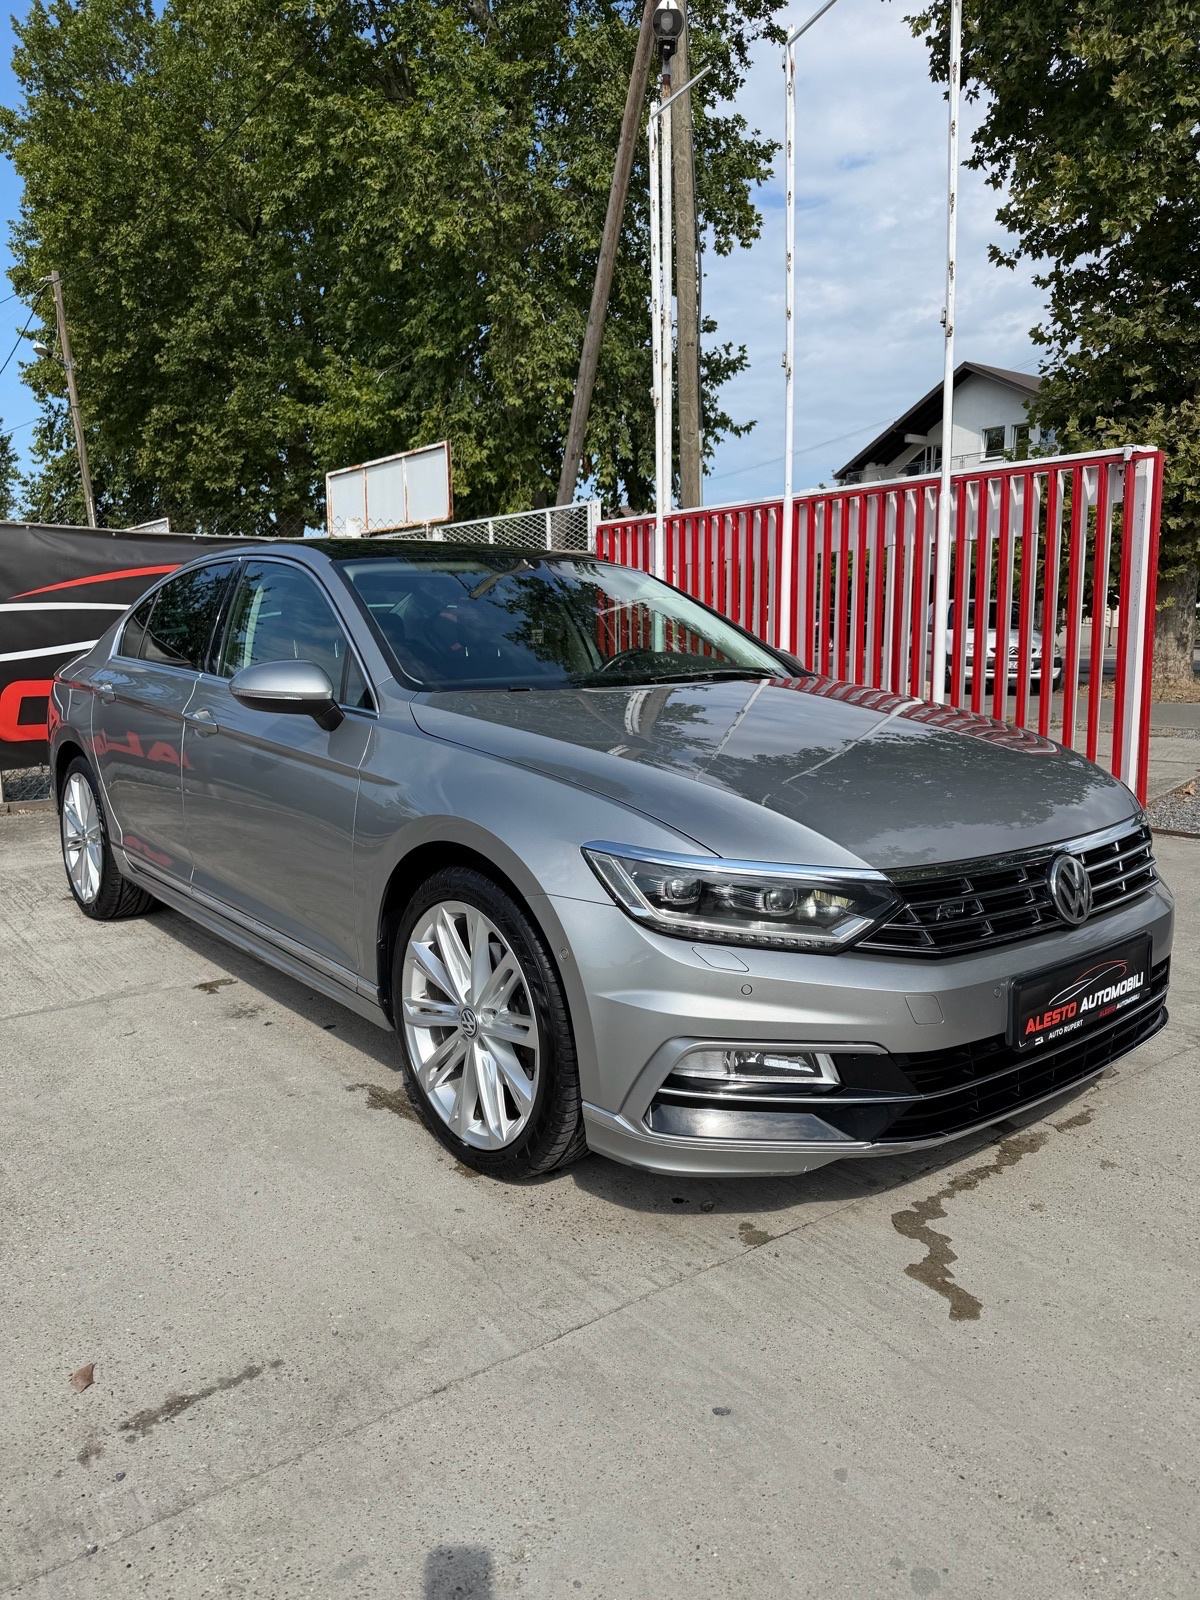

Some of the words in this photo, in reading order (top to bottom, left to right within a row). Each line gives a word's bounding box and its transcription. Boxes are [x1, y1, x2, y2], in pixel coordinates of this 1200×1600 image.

[1025, 1002, 1077, 1035] ALESTO
[1080, 972, 1143, 1013] AUTOMOBILI
[1048, 1026, 1064, 1039] AUTO
